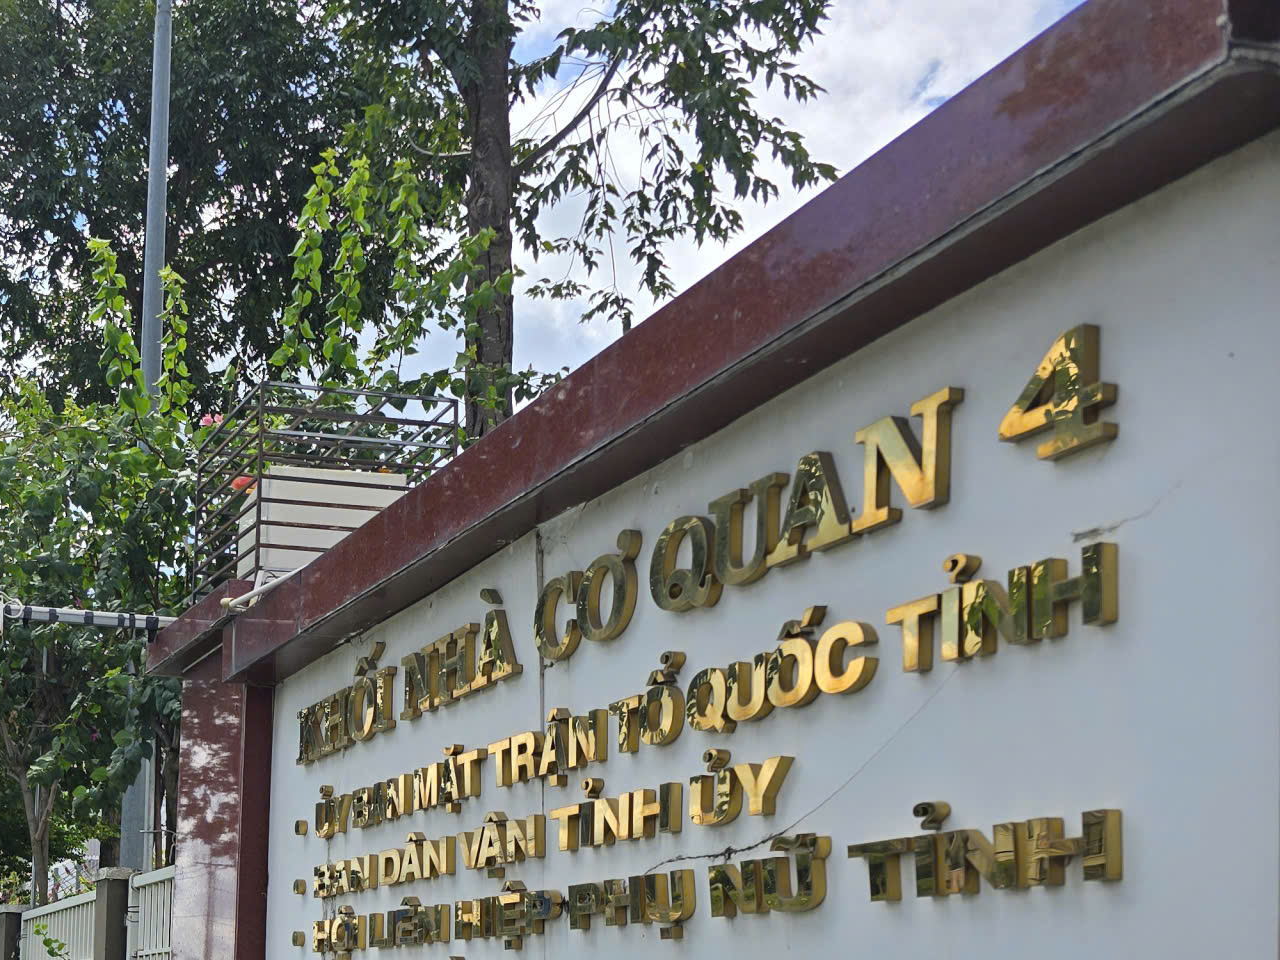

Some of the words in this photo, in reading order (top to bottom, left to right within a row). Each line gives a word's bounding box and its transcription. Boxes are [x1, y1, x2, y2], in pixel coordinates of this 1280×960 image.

[296, 641, 397, 765] KHỐI
[400, 588, 523, 721] NHÀ
[534, 529, 642, 661] CƠ
[650, 386, 964, 613] QUAN
[998, 323, 1118, 461] 4
[315, 785, 353, 839] ỦY
[352, 774, 413, 828] BAN
[413, 744, 488, 813] MẶT
[488, 708, 608, 787] TRẬN
[608, 651, 686, 753] TỔ
[686, 605, 879, 733] QUỐC
[887, 554, 1118, 673] TỈNH
[314, 854, 378, 898] BAN
[378, 832, 456, 886] DÂN
[456, 811, 546, 878] VẬN
[549, 777, 683, 851] TỈNH
[688, 748, 795, 827] ỦY
[369, 896, 450, 948] LIÊN
[455, 880, 564, 950] HIỆP
[568, 869, 695, 940] PHỤ
[708, 833, 832, 917] NỮ
[847, 802, 1123, 902] TỈNH
